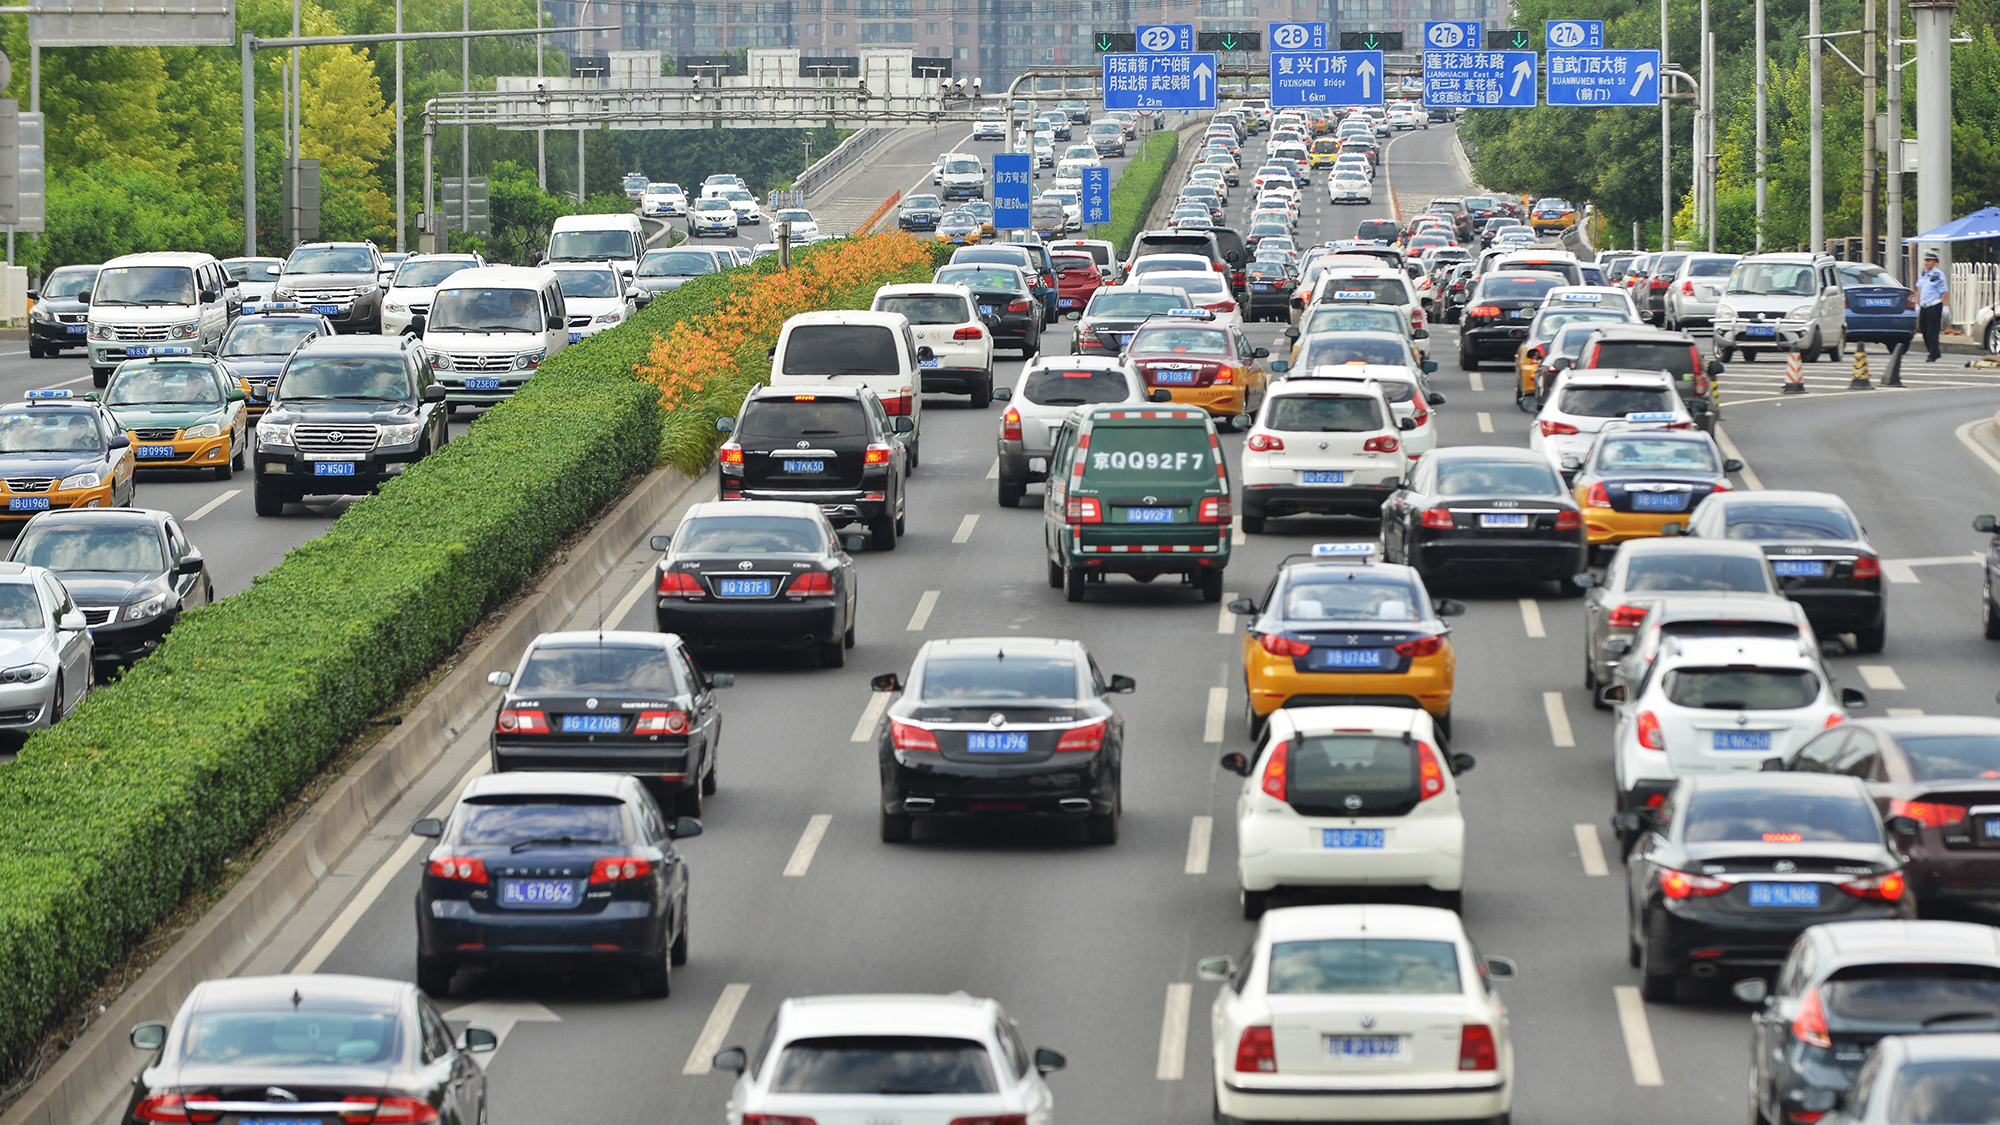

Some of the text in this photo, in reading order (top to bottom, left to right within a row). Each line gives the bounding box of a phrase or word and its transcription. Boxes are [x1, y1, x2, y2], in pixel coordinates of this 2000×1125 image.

[1147, 31, 1170, 47] 29
[1180, 27, 1190, 50] 出口
[1281, 28, 1303, 45] 28
[1313, 24, 1322, 47] 出口
[1435, 26, 1457, 43] 27B
[1467, 24, 1476, 48] 出口
[1556, 26, 1579, 43] 27A
[1590, 23, 1599, 47] 出口
[1108, 57, 1191, 74] 月坛南街 广宁伯街
[1278, 56, 1348, 75] 复兴门桥
[1427, 53, 1505, 70] 莲花池东路
[1552, 56, 1628, 74] 宣武门西大街
[1108, 75, 1191, 92] 月坛北街 武定侯街
[1279, 78, 1346, 88] FUXINGMEN Bridge
[1427, 71, 1504, 79] LIANHUACHI East Rd
[1552, 76, 1626, 85] XUANWUMEN West St
[996, 171, 1028, 184] 前方弯道
[1090, 170, 1104, 221] 天宁寺桥
[1093, 452, 1205, 471] 京QQ92F7
